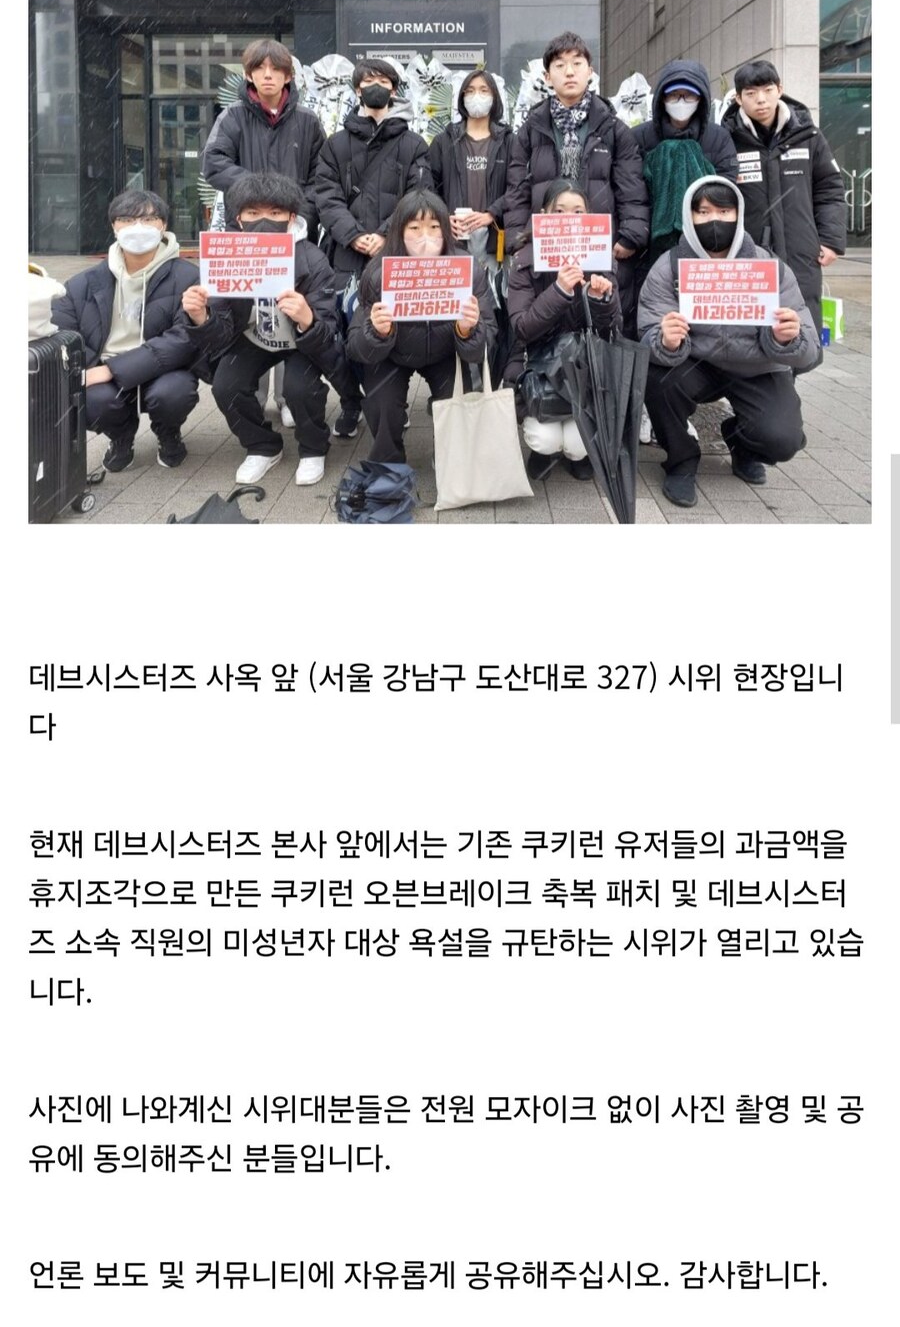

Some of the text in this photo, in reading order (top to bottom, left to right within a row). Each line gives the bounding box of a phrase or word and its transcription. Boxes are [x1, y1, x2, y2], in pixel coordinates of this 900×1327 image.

[371, 23, 465, 33] INFORMATION
[393, 299, 460, 317] 사과하라!
[394, 290, 454, 301] 데브시스터즈는
[693, 294, 758, 303] 데브시스터즈는
[692, 304, 766, 320] 사과하라!
[30, 661, 841, 693] 데브시스터즈 사옥 앞 (서울 강남구 도산대로 327) 시위 현장입니
[30, 713, 56, 741] 다
[30, 830, 847, 859] 현재 데브시스터즈 본사 앞에서는 기존 쿠키런 유저들의 과금액을
[29, 879, 845, 908] 휴지조각으로 만든 쿠키런 오븐브레이크 축복 패치 및 데브시스터
[29, 928, 864, 957] 즈 소속 직원의 미성년자 대상 욕설을 규탄하는 시위가 열리고 있습
[31, 978, 91, 1006] 니다.
[29, 1095, 864, 1124] 사진에 나와계신 시위대분들은 전원 모자이크 없이 사진 촬영 및 공
[29, 1144, 390, 1173] 유에 동의해주신 분들입니다.
[30, 1261, 827, 1290] 언론 보도 및 커뮤니티에 자유롭게 공유해주십시오. 감사합니다.
